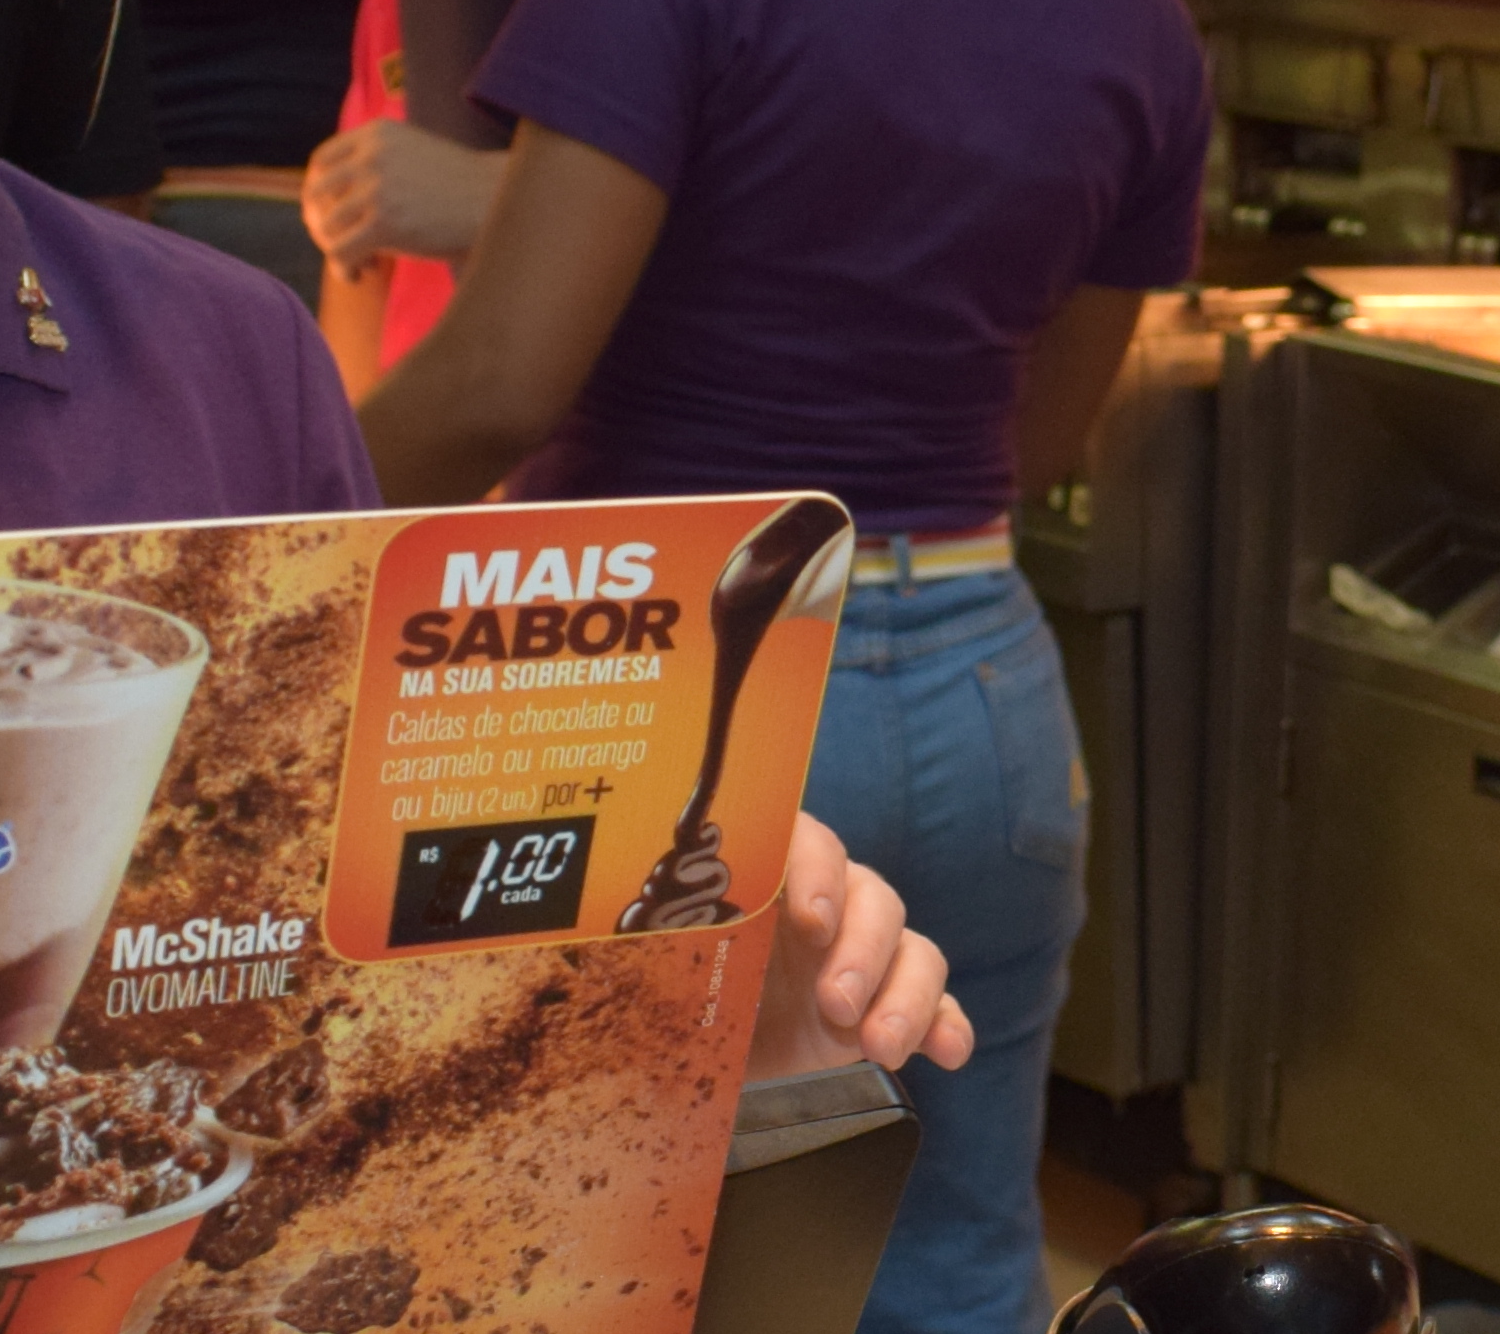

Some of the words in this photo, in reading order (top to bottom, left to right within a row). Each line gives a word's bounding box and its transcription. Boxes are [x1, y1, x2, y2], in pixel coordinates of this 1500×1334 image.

[439, 542, 657, 609] MAIS
[394, 598, 681, 668] SABOR
[399, 669, 435, 699] NA
[441, 664, 494, 695] SUA
[500, 655, 661, 692] SOBREMESA
[386, 710, 466, 746] Caldas
[472, 705, 503, 738] de
[508, 698, 620, 735] chocolate
[625, 700, 656, 726] ou
[380, 744, 494, 784] caramelo
[502, 748, 533, 774] ou
[541, 739, 647, 772] morango
[391, 795, 422, 822] ou
[430, 785, 473, 822] biju
[477, 787, 499, 815] (2
[502, 785, 538, 813] un.)
[541, 781, 583, 814] por
[419, 846, 440, 863] R$
[460, 830, 577, 922] 1.00
[500, 884, 542, 905] cada
[111, 911, 306, 972] McShake
[106, 957, 299, 1018] OVOMALTINE
